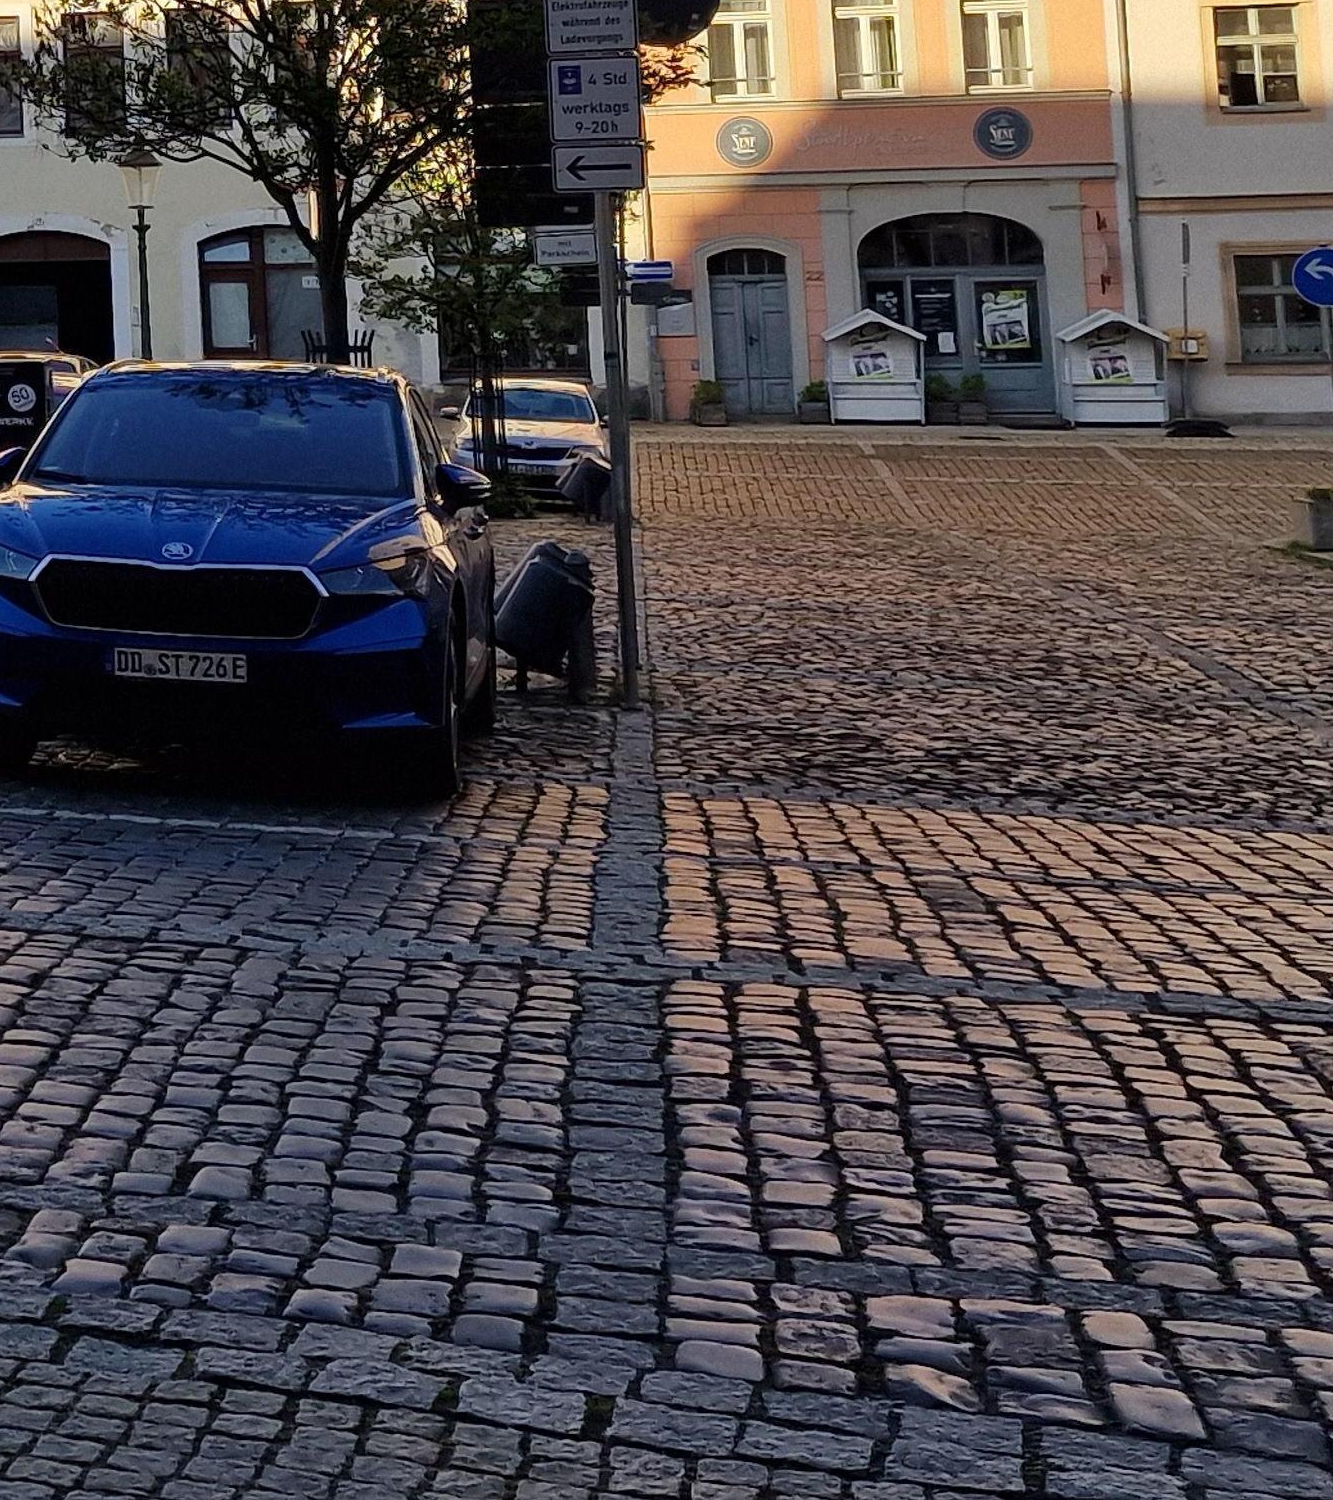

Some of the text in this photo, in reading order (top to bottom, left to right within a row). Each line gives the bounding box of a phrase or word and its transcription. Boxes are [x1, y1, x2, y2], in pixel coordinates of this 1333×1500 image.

[588, 72, 627, 85] 4 Std
[562, 101, 630, 117] werktags
[116, 650, 143, 673] DD
